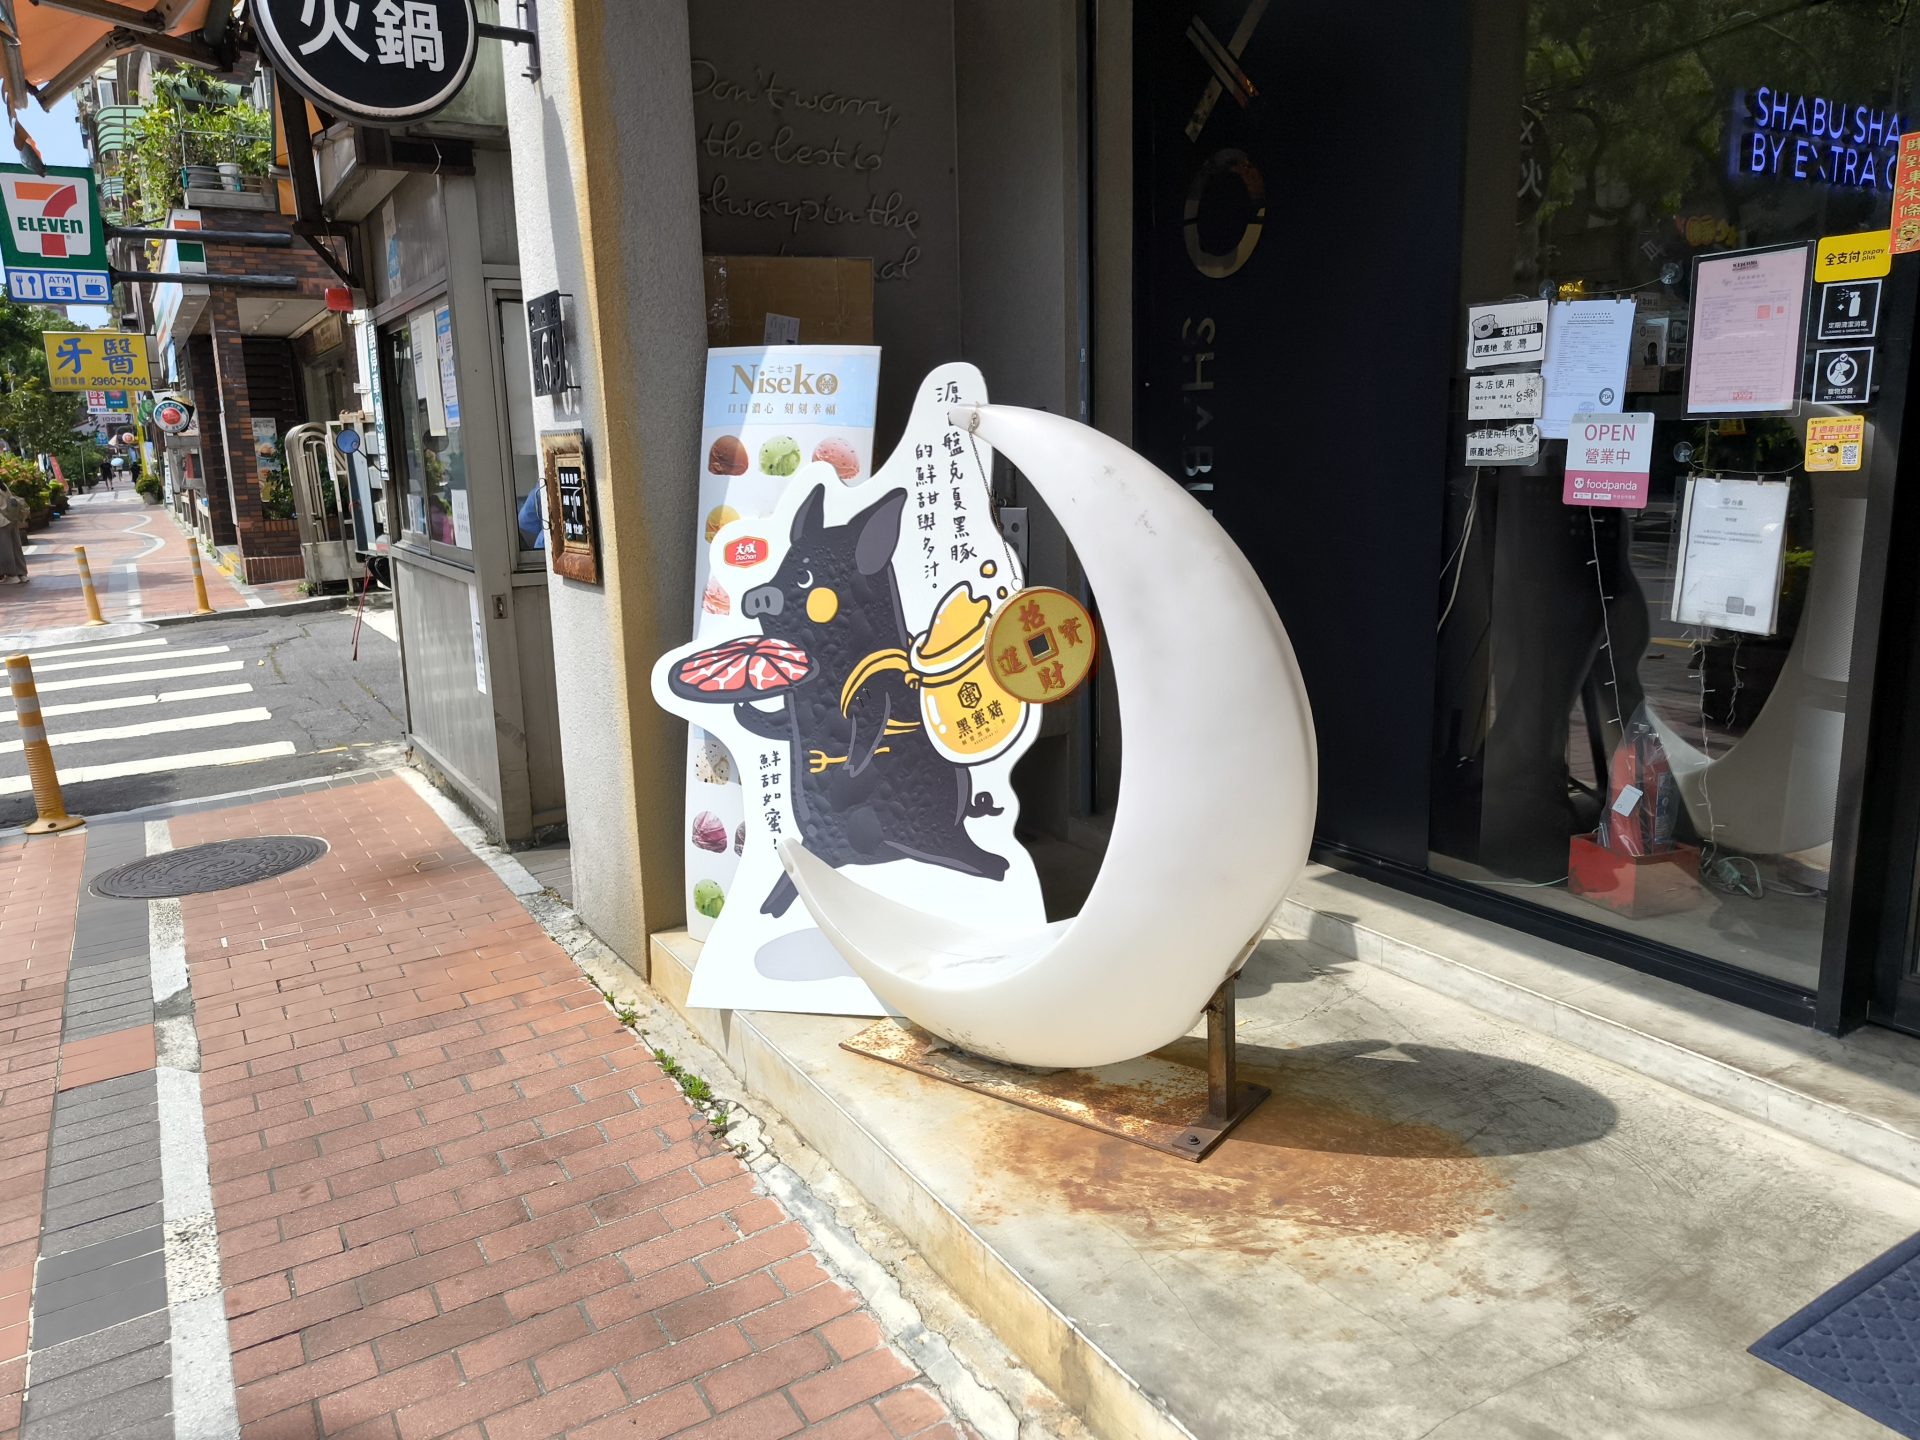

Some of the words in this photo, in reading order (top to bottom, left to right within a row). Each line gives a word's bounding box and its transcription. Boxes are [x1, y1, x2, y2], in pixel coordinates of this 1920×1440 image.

[298, 0, 445, 72] 火鍋
[790, 90, 902, 131] worry,
[1756, 86, 1846, 140] SHABU
[703, 120, 763, 159] the
[1751, 132, 1786, 174] BY
[700, 175, 820, 233] lways
[1824, 250, 1861, 266] 全支付
[48, 276, 71, 285] ATM
[56, 337, 138, 375] 牙醫
[1475, 343, 1498, 354] 原產地
[728, 362, 839, 396] Niseko
[768, 364, 793, 373] ニセコ
[91, 376, 148, 387] 2960-7504
[1474, 379, 1516, 391] 本店使用
[784, 402, 836, 416] 刻刻幸福
[1469, 427, 1518, 440] 本店使用牛肉
[1584, 424, 1636, 442] OPEN
[1469, 446, 1493, 457] 原產地
[1585, 447, 1631, 465] 營業中
[935, 380, 978, 564] 源盤克夏黑豚
[1586, 478, 1638, 492] foodpanda
[736, 540, 757, 555] 大成
[1018, 599, 1046, 632] 招
[996, 646, 1028, 677] 進
[1037, 660, 1066, 694] 財
[955, 699, 1004, 739] 黑蜜豬
